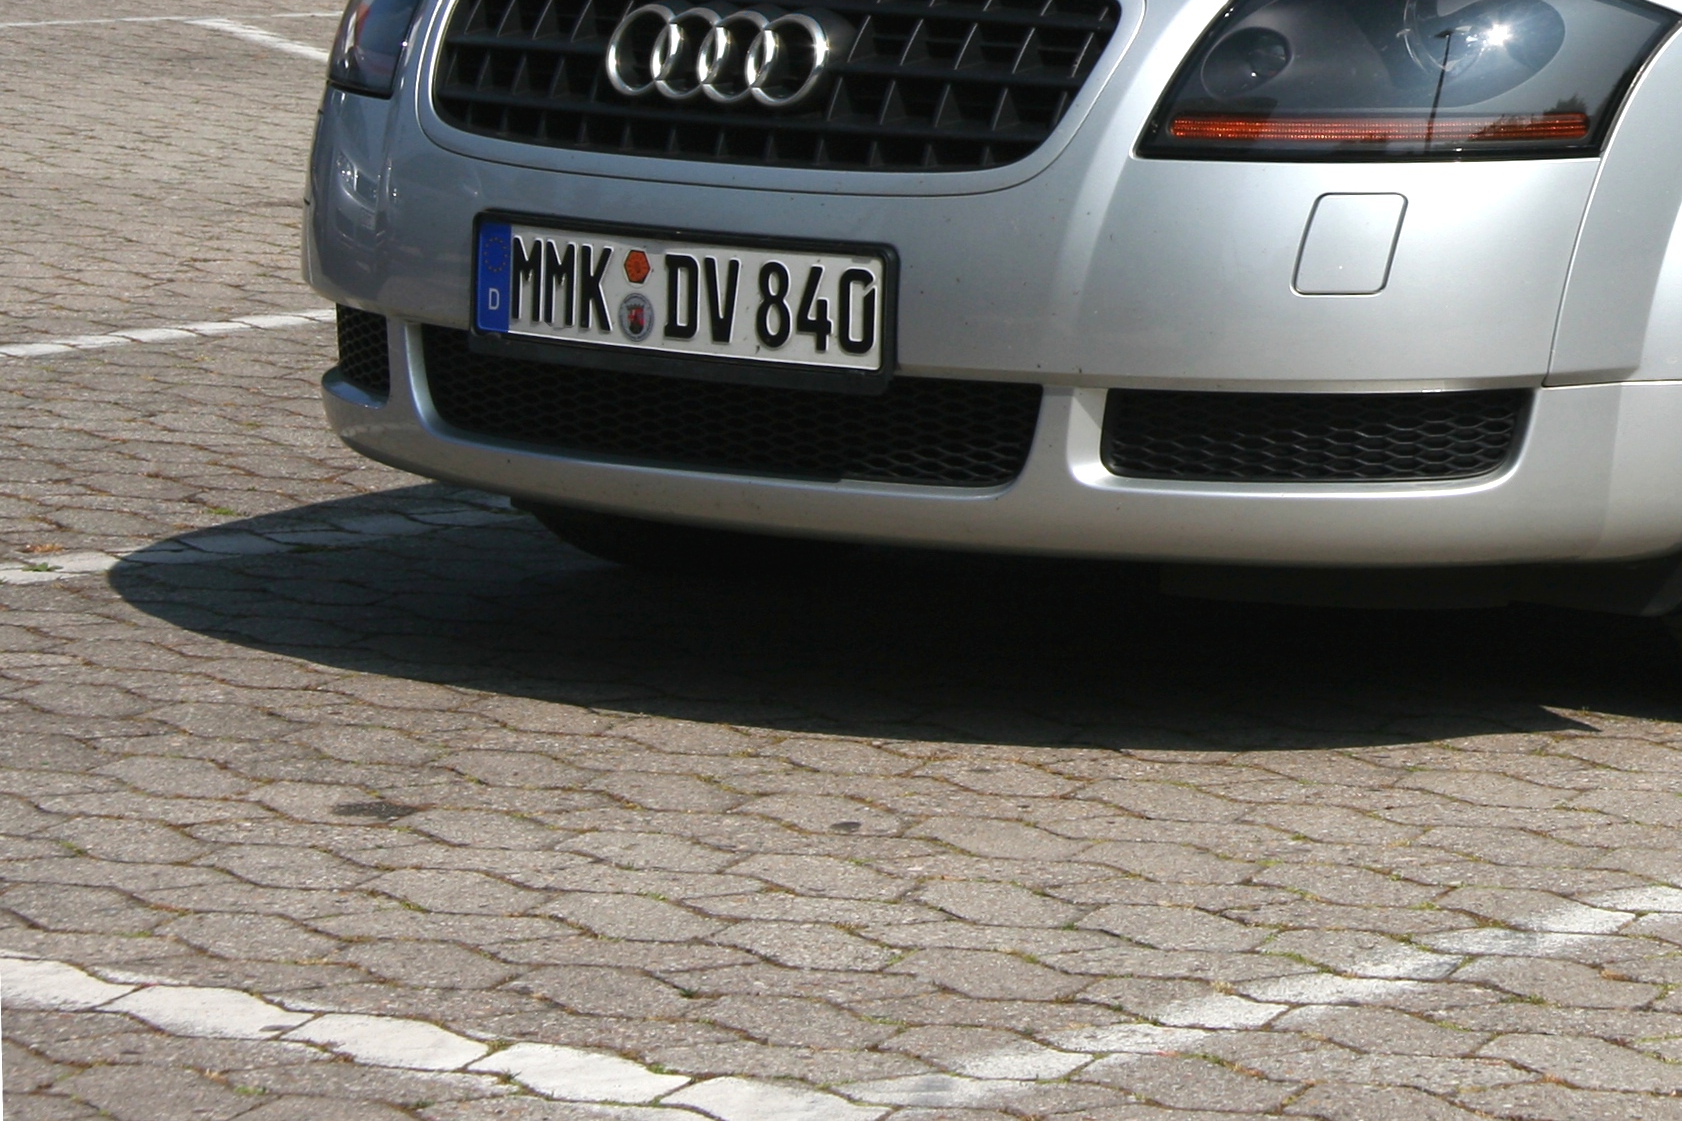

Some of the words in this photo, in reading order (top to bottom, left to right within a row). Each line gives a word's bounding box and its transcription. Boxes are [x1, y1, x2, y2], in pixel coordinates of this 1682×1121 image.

[488, 288, 499, 310] D
[512, 235, 613, 332] MMK
[663, 252, 741, 344] DV
[755, 260, 877, 354] 840
